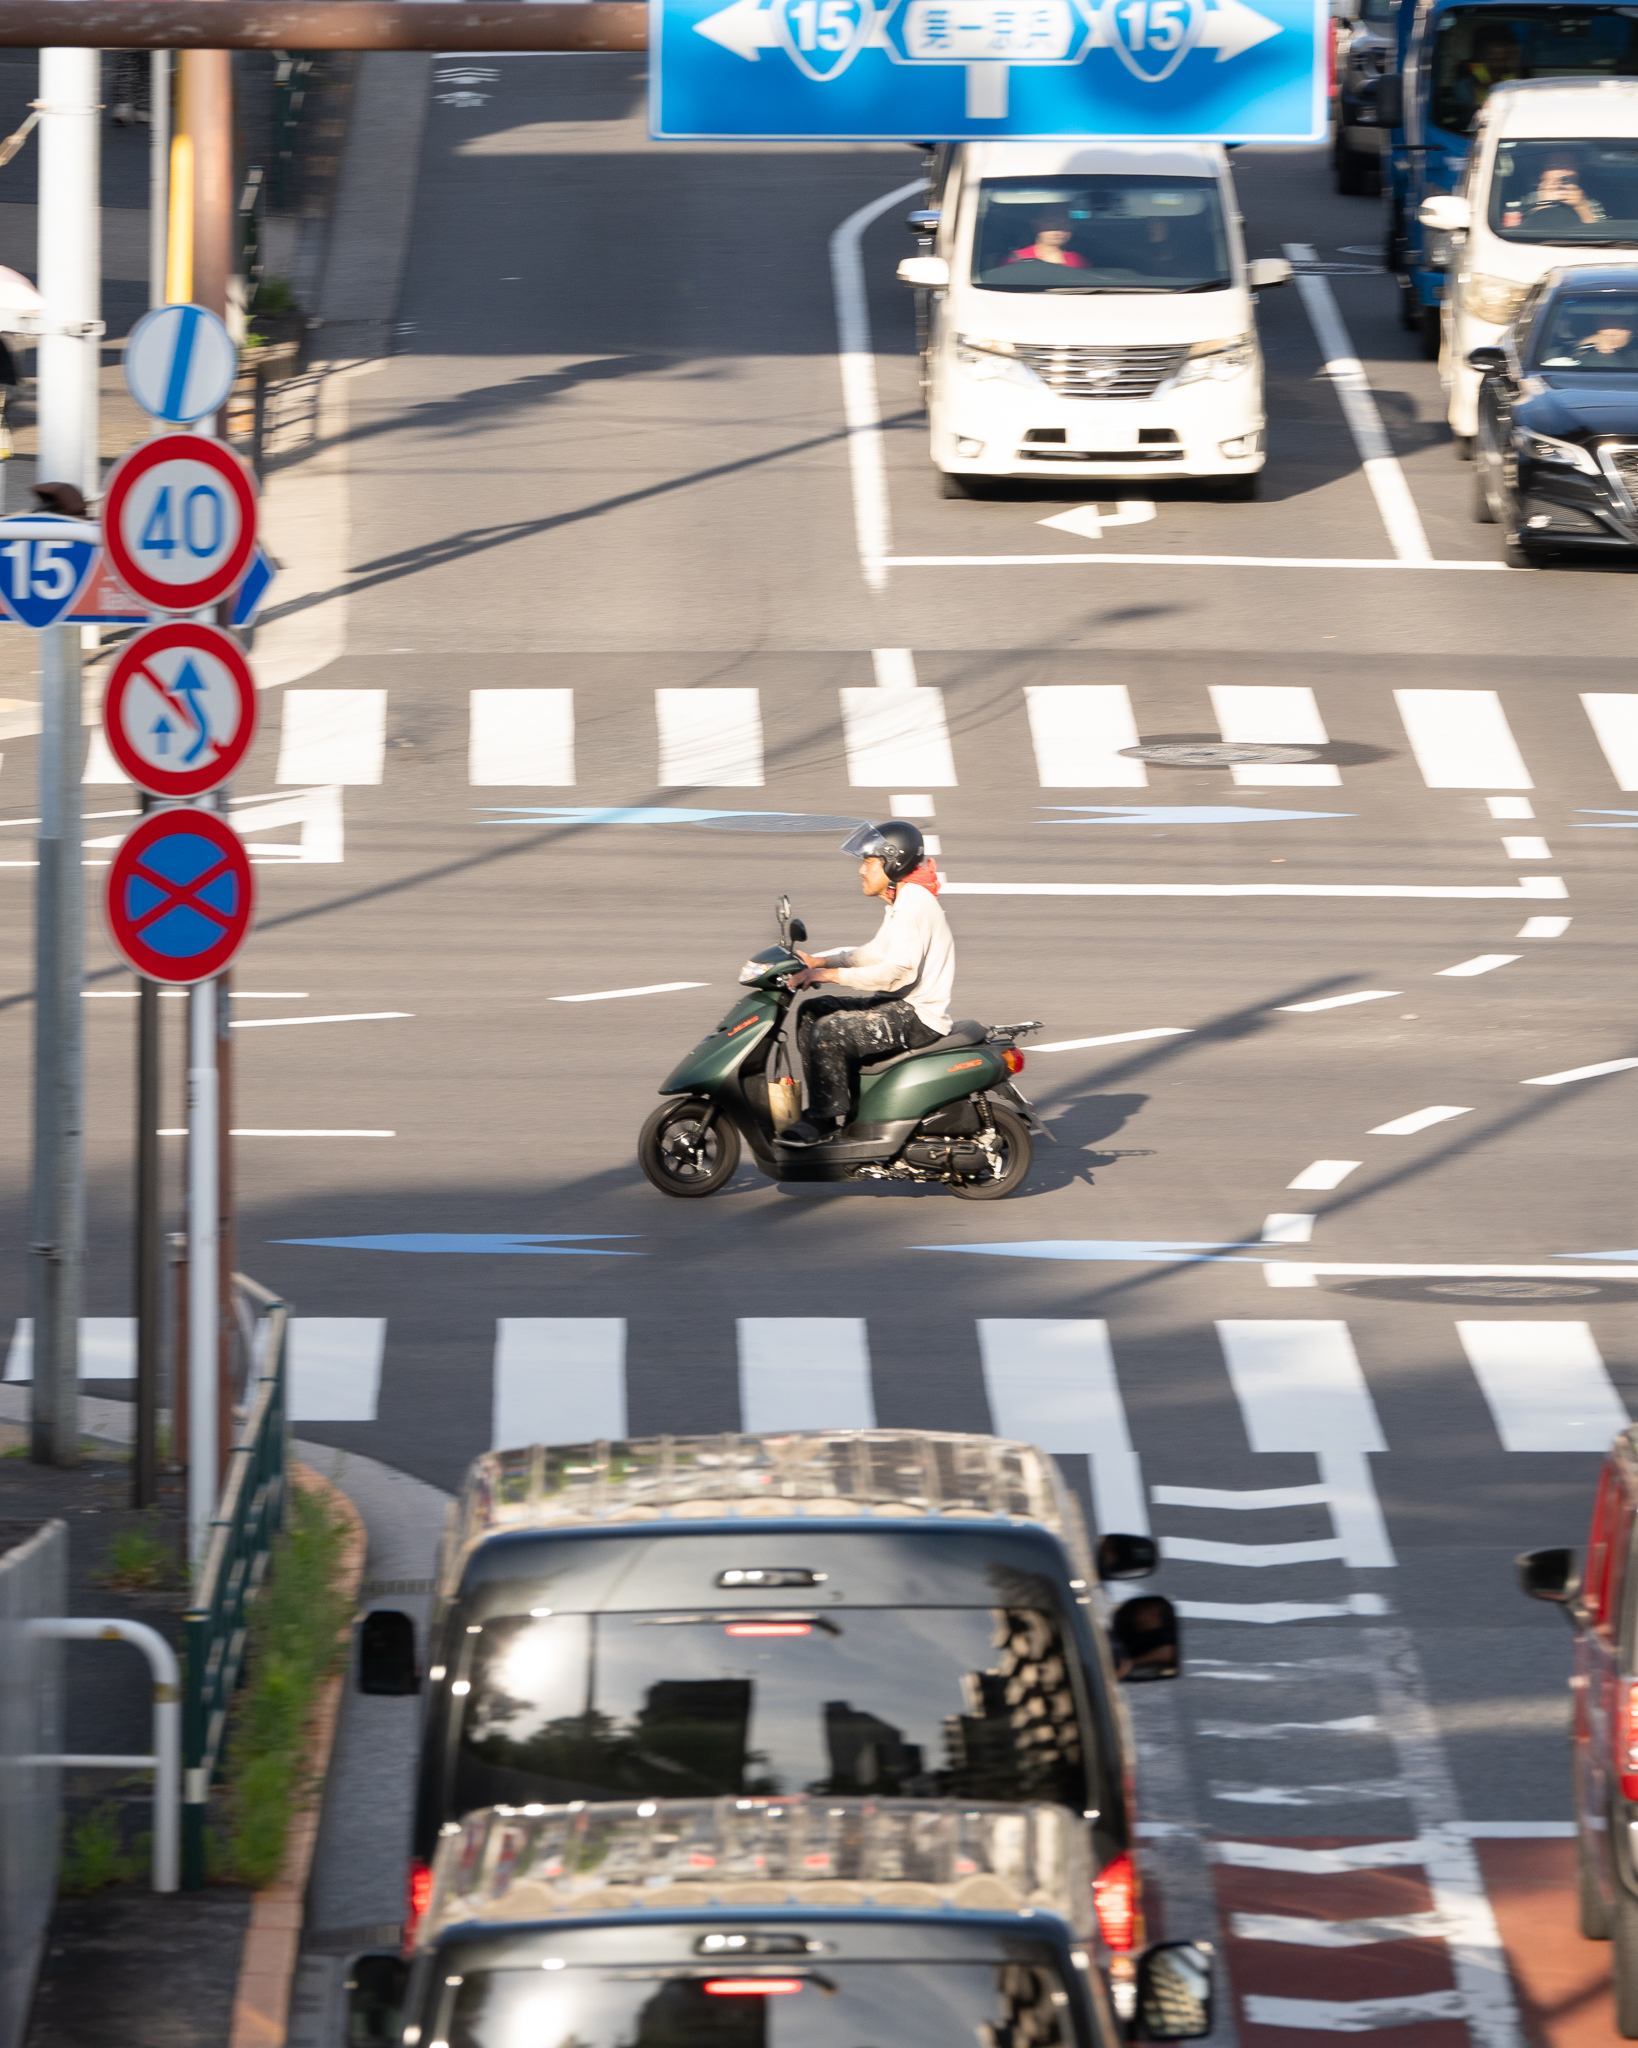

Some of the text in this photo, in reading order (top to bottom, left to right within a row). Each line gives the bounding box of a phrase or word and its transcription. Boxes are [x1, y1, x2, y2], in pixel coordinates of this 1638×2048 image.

[789, 0, 854, 51] 15
[1119, 0, 1186, 51] 15
[140, 484, 226, 559] 40
[2, 540, 77, 600] 15
